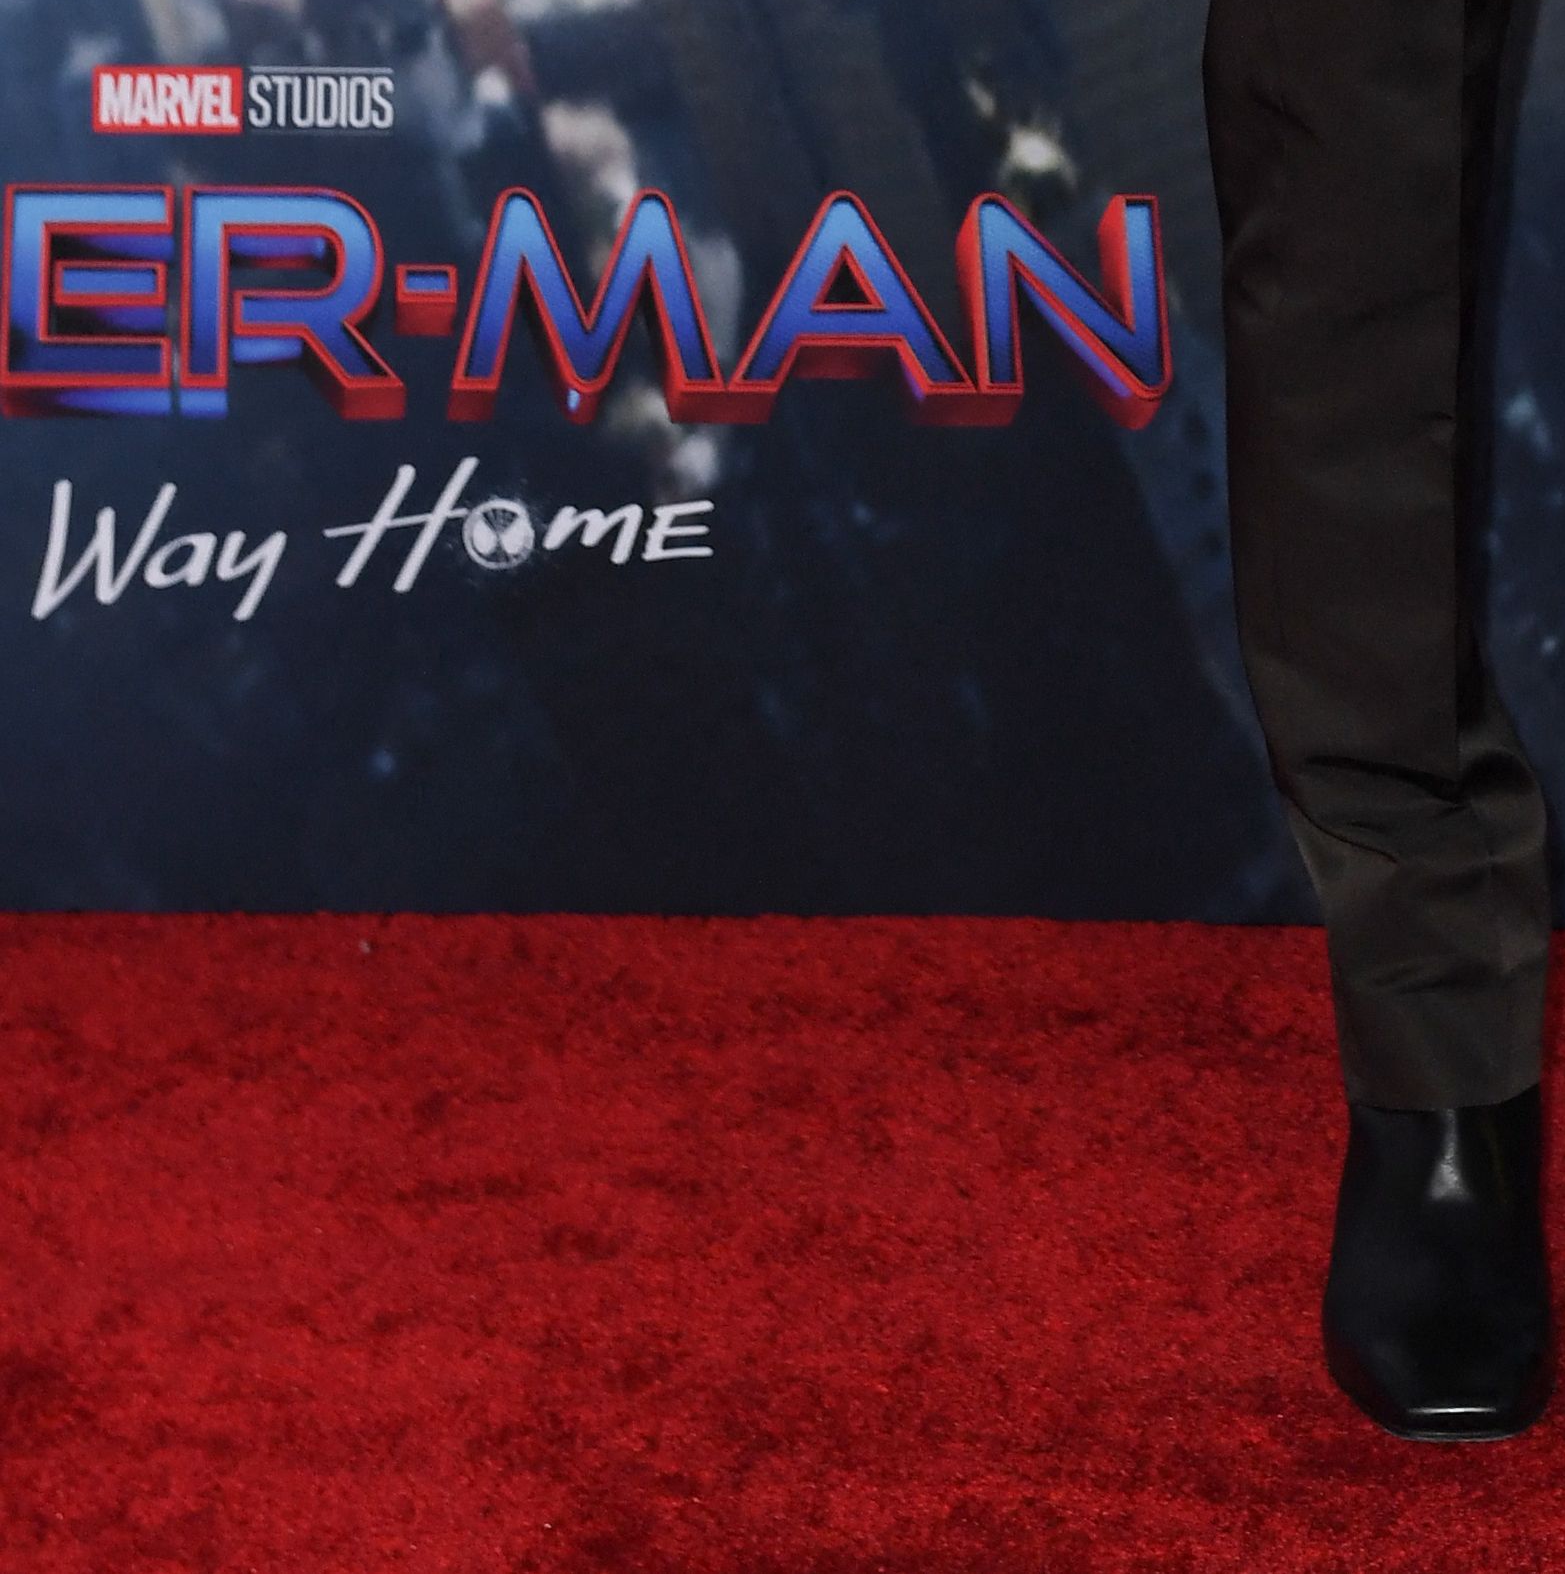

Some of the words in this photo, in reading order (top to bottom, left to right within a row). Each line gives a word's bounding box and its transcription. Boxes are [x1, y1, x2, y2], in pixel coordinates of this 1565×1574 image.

[99, 72, 240, 128] MARVEL
[248, 74, 395, 129] STUDIOS
[30, 478, 288, 621] Way
